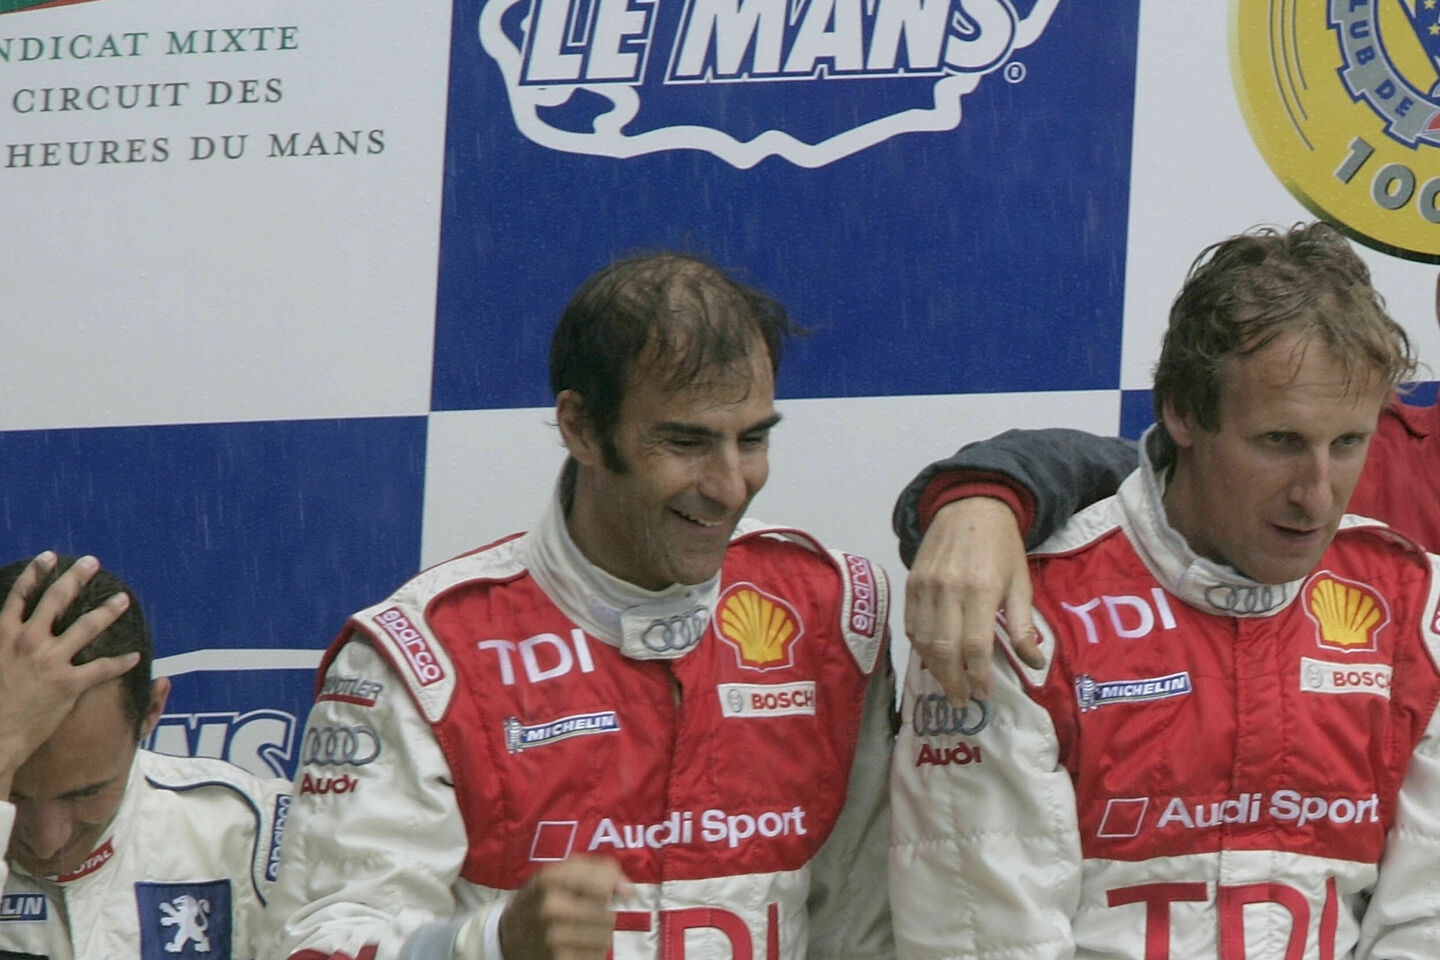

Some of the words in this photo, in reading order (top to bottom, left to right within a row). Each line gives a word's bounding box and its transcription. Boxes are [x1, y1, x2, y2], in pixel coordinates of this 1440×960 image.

[166, 26, 299, 55] MIXTE
[12, 82, 189, 113] CIRCUIT
[207, 78, 283, 105] DES
[5, 137, 169, 168] HEURES
[190, 134, 247, 161] DU
[267, 129, 386, 158] MANS
[377, 608, 442, 684] sparco
[477, 629, 595, 685] TDI
[751, 690, 815, 711] BOSCH
[1102, 677, 1185, 699] MICHELIN
[526, 714, 616, 742] MICHELIN
[1157, 793, 1262, 829] Audi
[1269, 790, 1379, 827] Sport
[588, 810, 692, 851] Audi
[702, 806, 806, 847] Sport
[73, 848, 113, 875] OTAL
[0, 896, 44, 916] LIN
